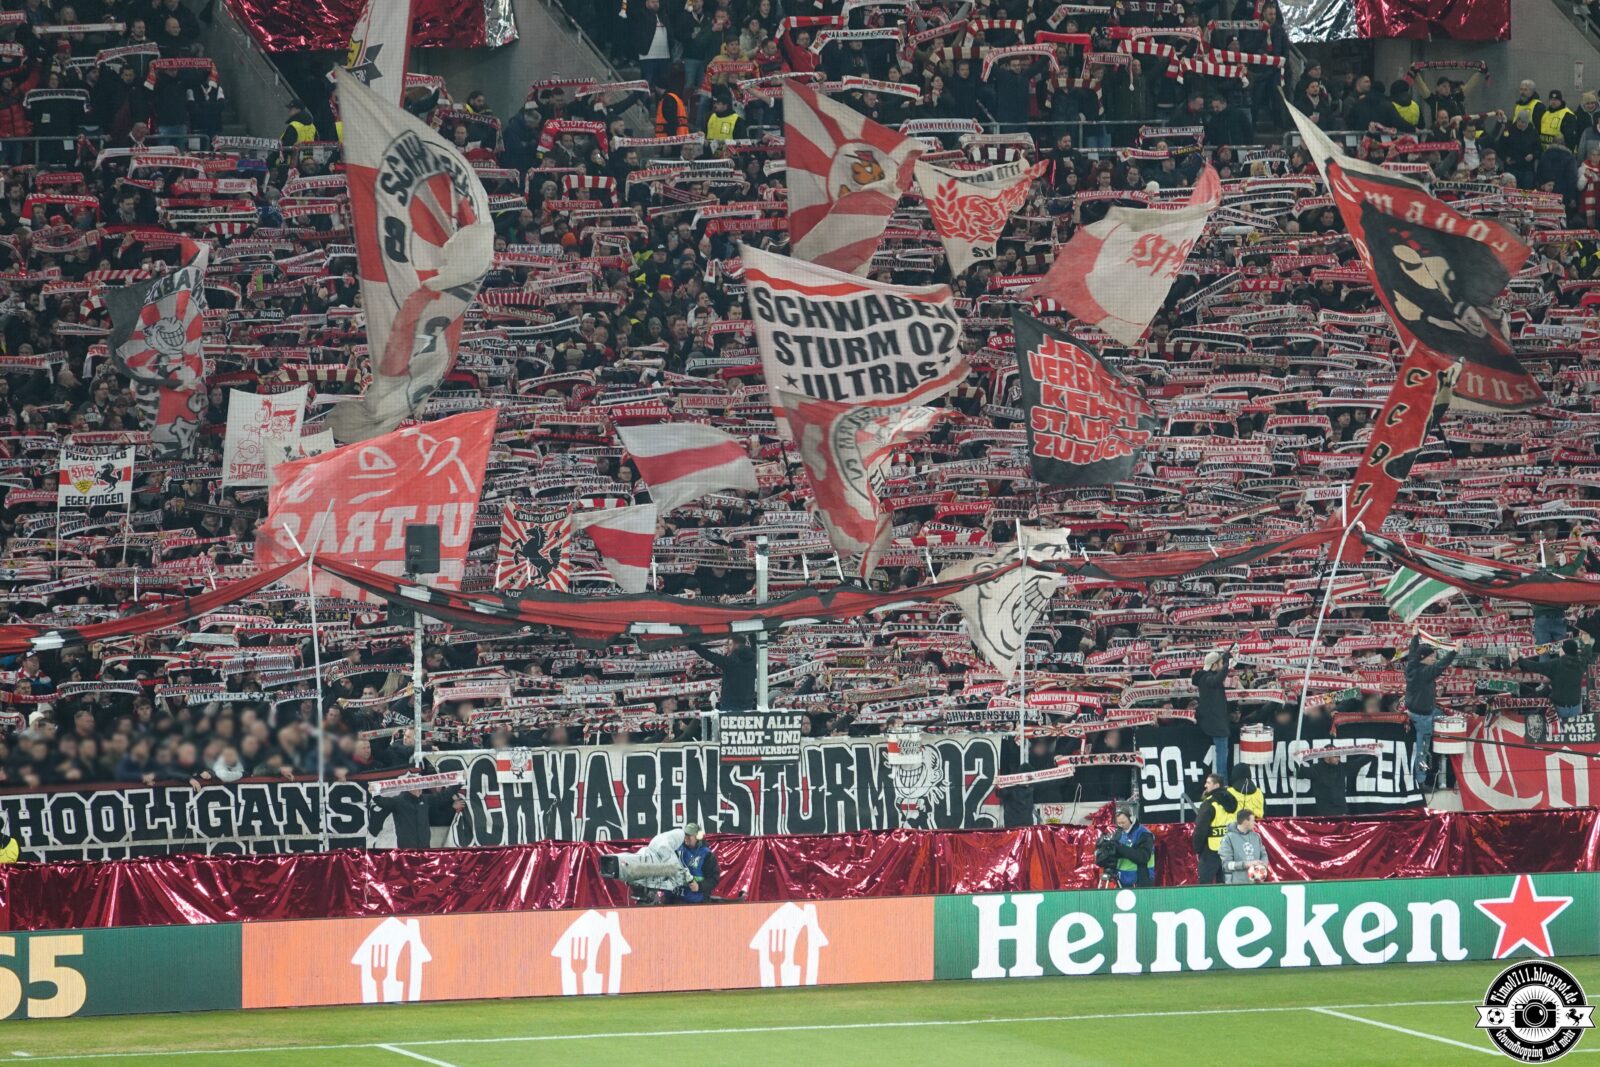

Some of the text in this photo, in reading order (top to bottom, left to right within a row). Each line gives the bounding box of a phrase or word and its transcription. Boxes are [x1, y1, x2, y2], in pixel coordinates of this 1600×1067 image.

[135, 156, 200, 168] STUTTGART
[1246, 281, 1278, 289] VfB
[772, 321, 957, 368] STURM 02
[802, 361, 939, 401] ULTRAS
[65, 492, 124, 506] EGELFINGEN
[721, 715, 801, 729] GEGEN ALLE
[721, 730, 800, 744] STADT- UND
[1569, 733, 1596, 742] UNS!
[934, 736, 999, 831] 02
[971, 884, 1468, 979] Heineken
